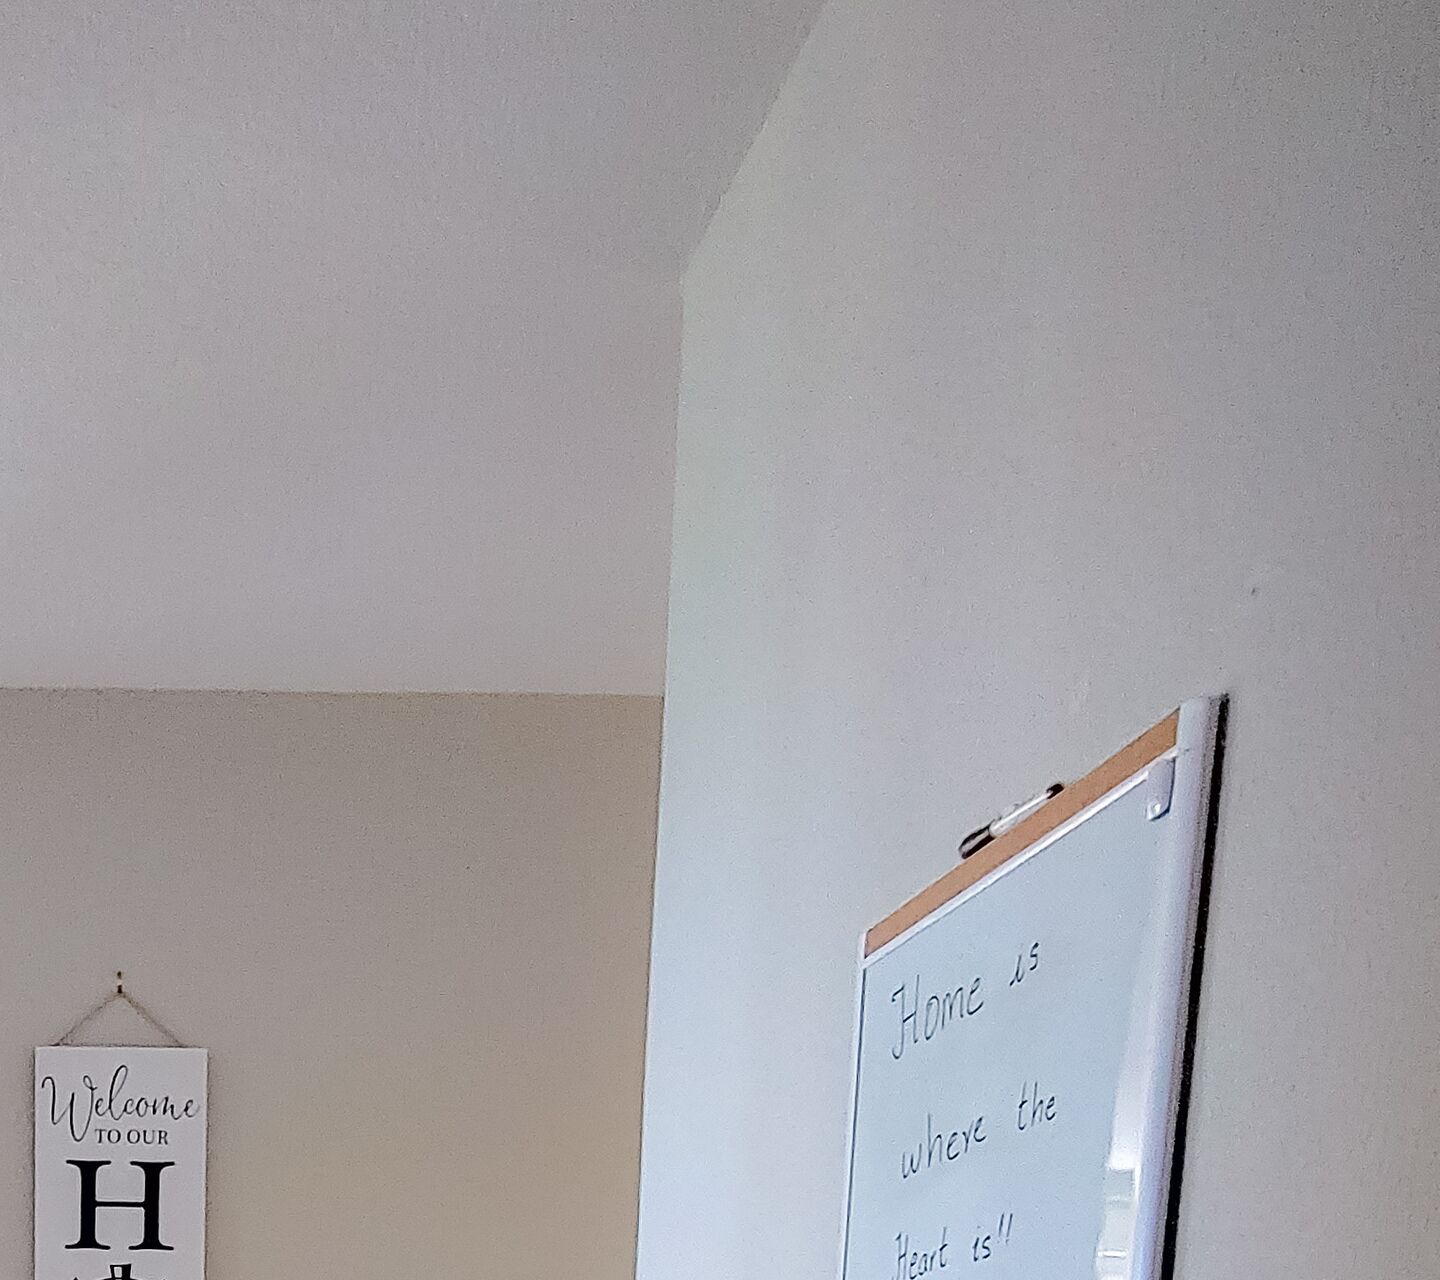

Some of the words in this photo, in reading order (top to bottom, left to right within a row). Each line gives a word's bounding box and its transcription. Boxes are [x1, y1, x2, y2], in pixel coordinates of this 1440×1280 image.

[891, 973, 984, 1060] Home
[1009, 942, 1039, 987] is
[41, 1064, 200, 1142] Welcome
[95, 1128, 121, 1145] TO
[126, 1128, 169, 1146] OUR
[901, 1112, 987, 1179] where
[1017, 1080, 1057, 1131] the
